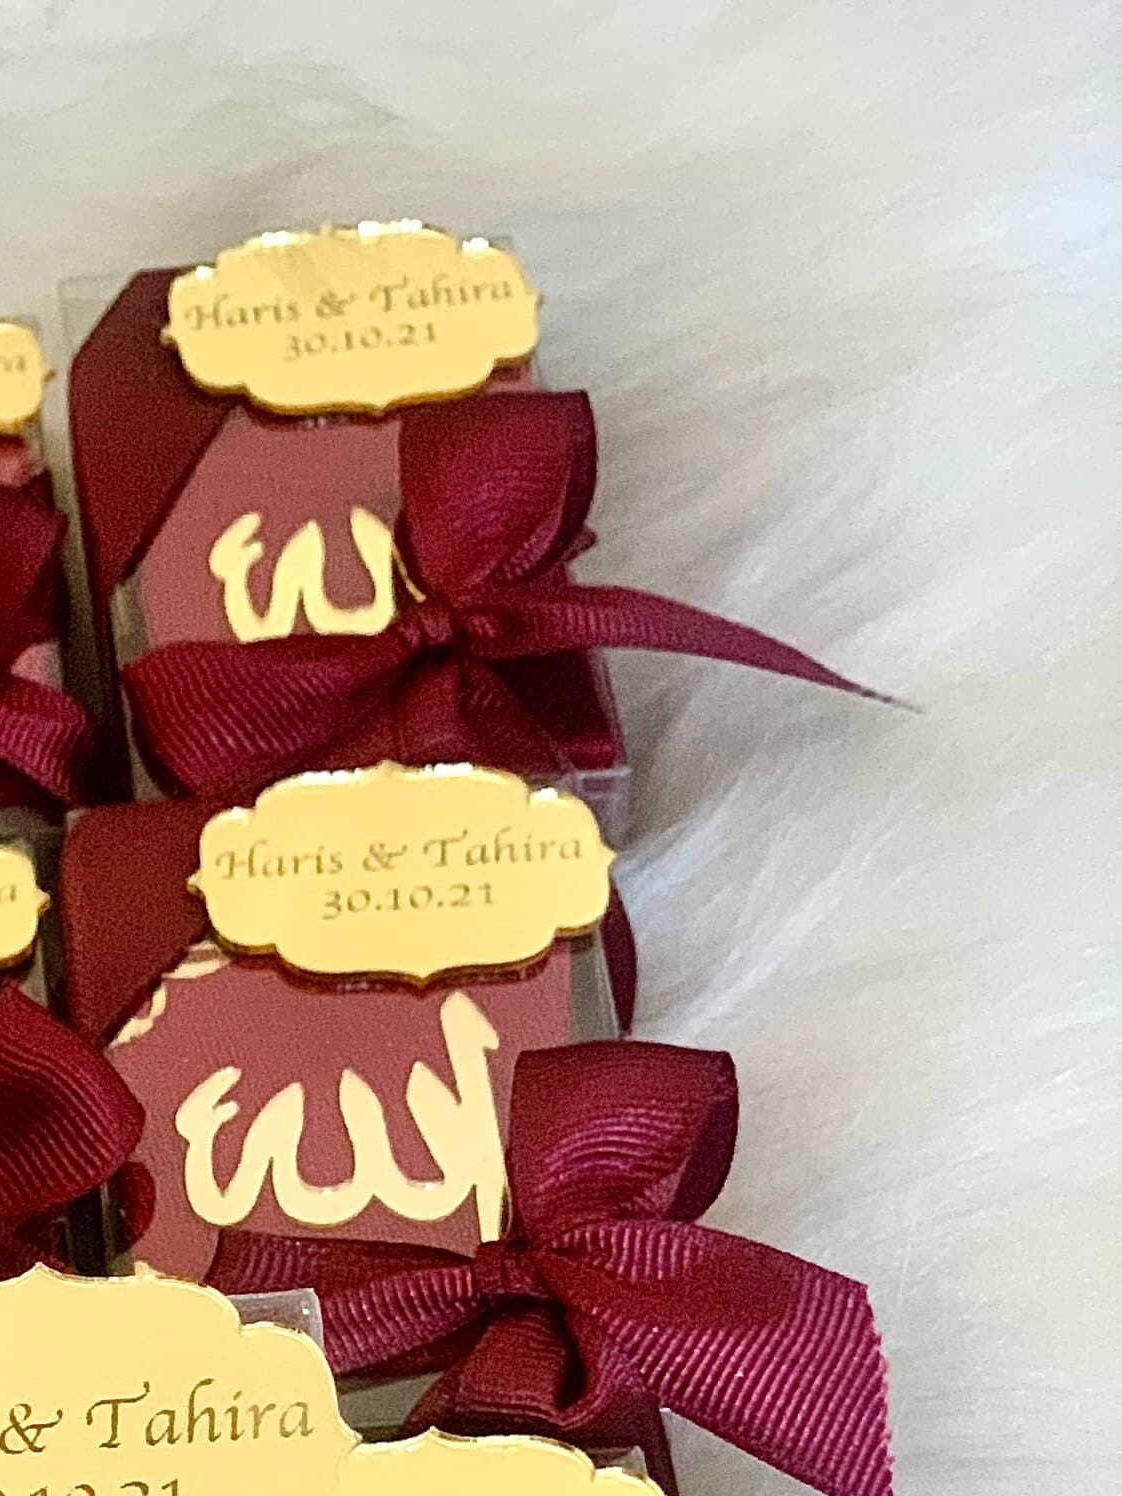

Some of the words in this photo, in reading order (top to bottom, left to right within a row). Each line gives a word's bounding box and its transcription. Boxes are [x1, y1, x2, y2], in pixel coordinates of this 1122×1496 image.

[184, 294, 301, 331] Haris
[315, 292, 358, 318] &
[369, 274, 514, 313] Tahira
[284, 322, 438, 362] 30.10.21
[215, 839, 344, 881] Haris
[362, 843, 408, 872] &
[422, 826, 584, 868] Tahira
[322, 882, 495, 920] 30.10.21
[85, 1377, 315, 1449] Tahira
